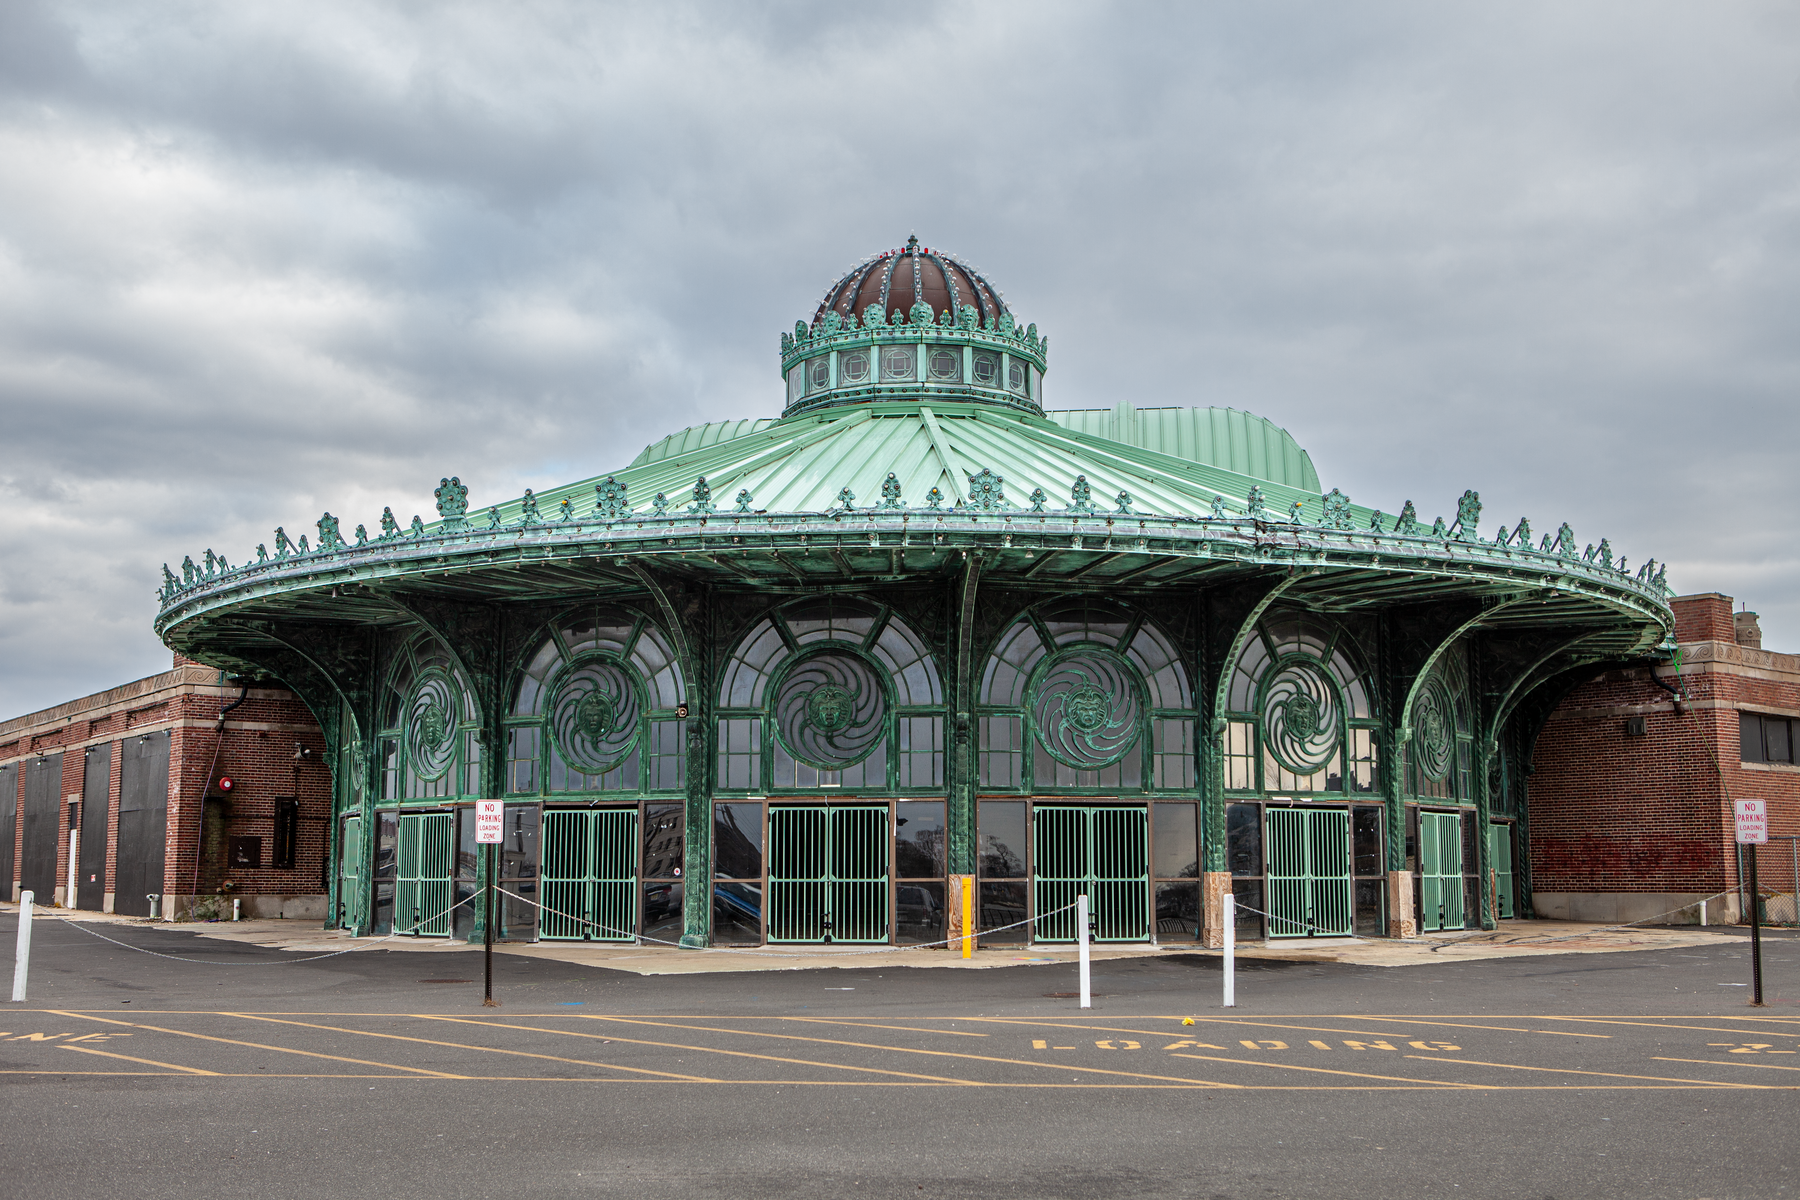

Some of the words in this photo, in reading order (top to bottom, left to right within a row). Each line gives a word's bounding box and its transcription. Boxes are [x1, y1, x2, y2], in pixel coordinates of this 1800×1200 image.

[485, 804, 494, 812] NO
[1745, 803, 1756, 811] NO
[1738, 814, 1764, 822] PARKING
[0, 1032, 133, 1042] NE
[1032, 1039, 1463, 1051] LOADING
